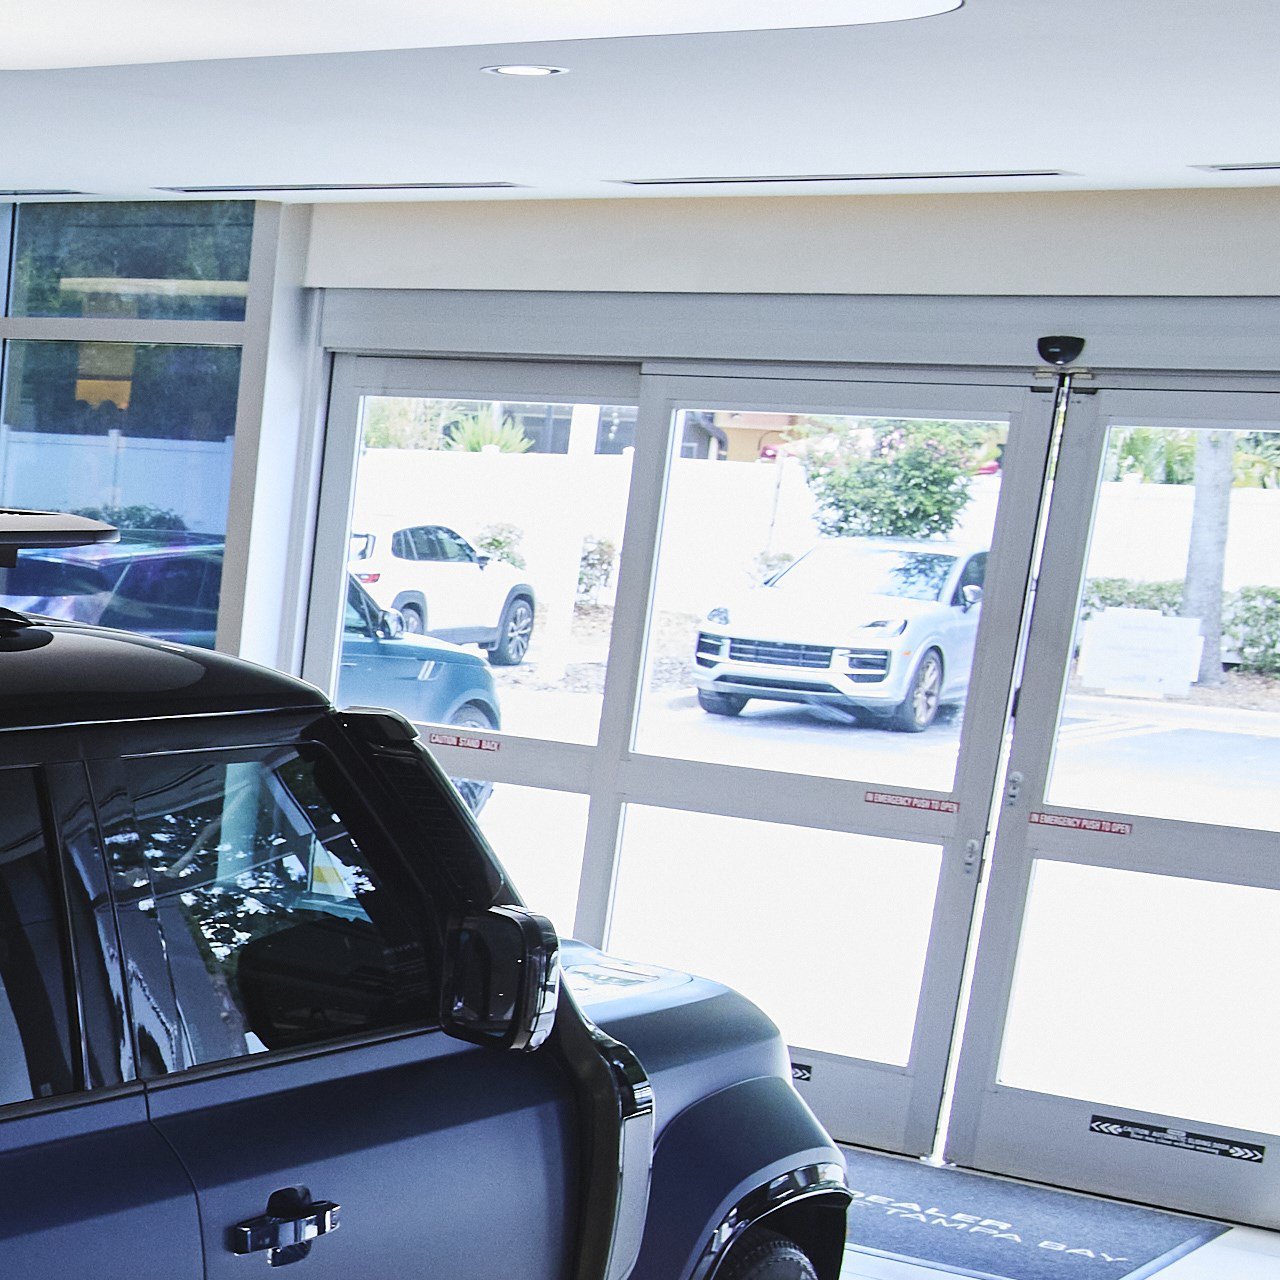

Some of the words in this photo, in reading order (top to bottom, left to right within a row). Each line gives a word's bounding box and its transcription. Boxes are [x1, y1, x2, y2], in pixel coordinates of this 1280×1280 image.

[874, 793, 911, 806] EMERGENCY
[1039, 813, 1081, 828] EMERGENCY
[884, 1206, 1022, 1243] TAMPA
[1038, 1240, 1128, 1262] BAY
